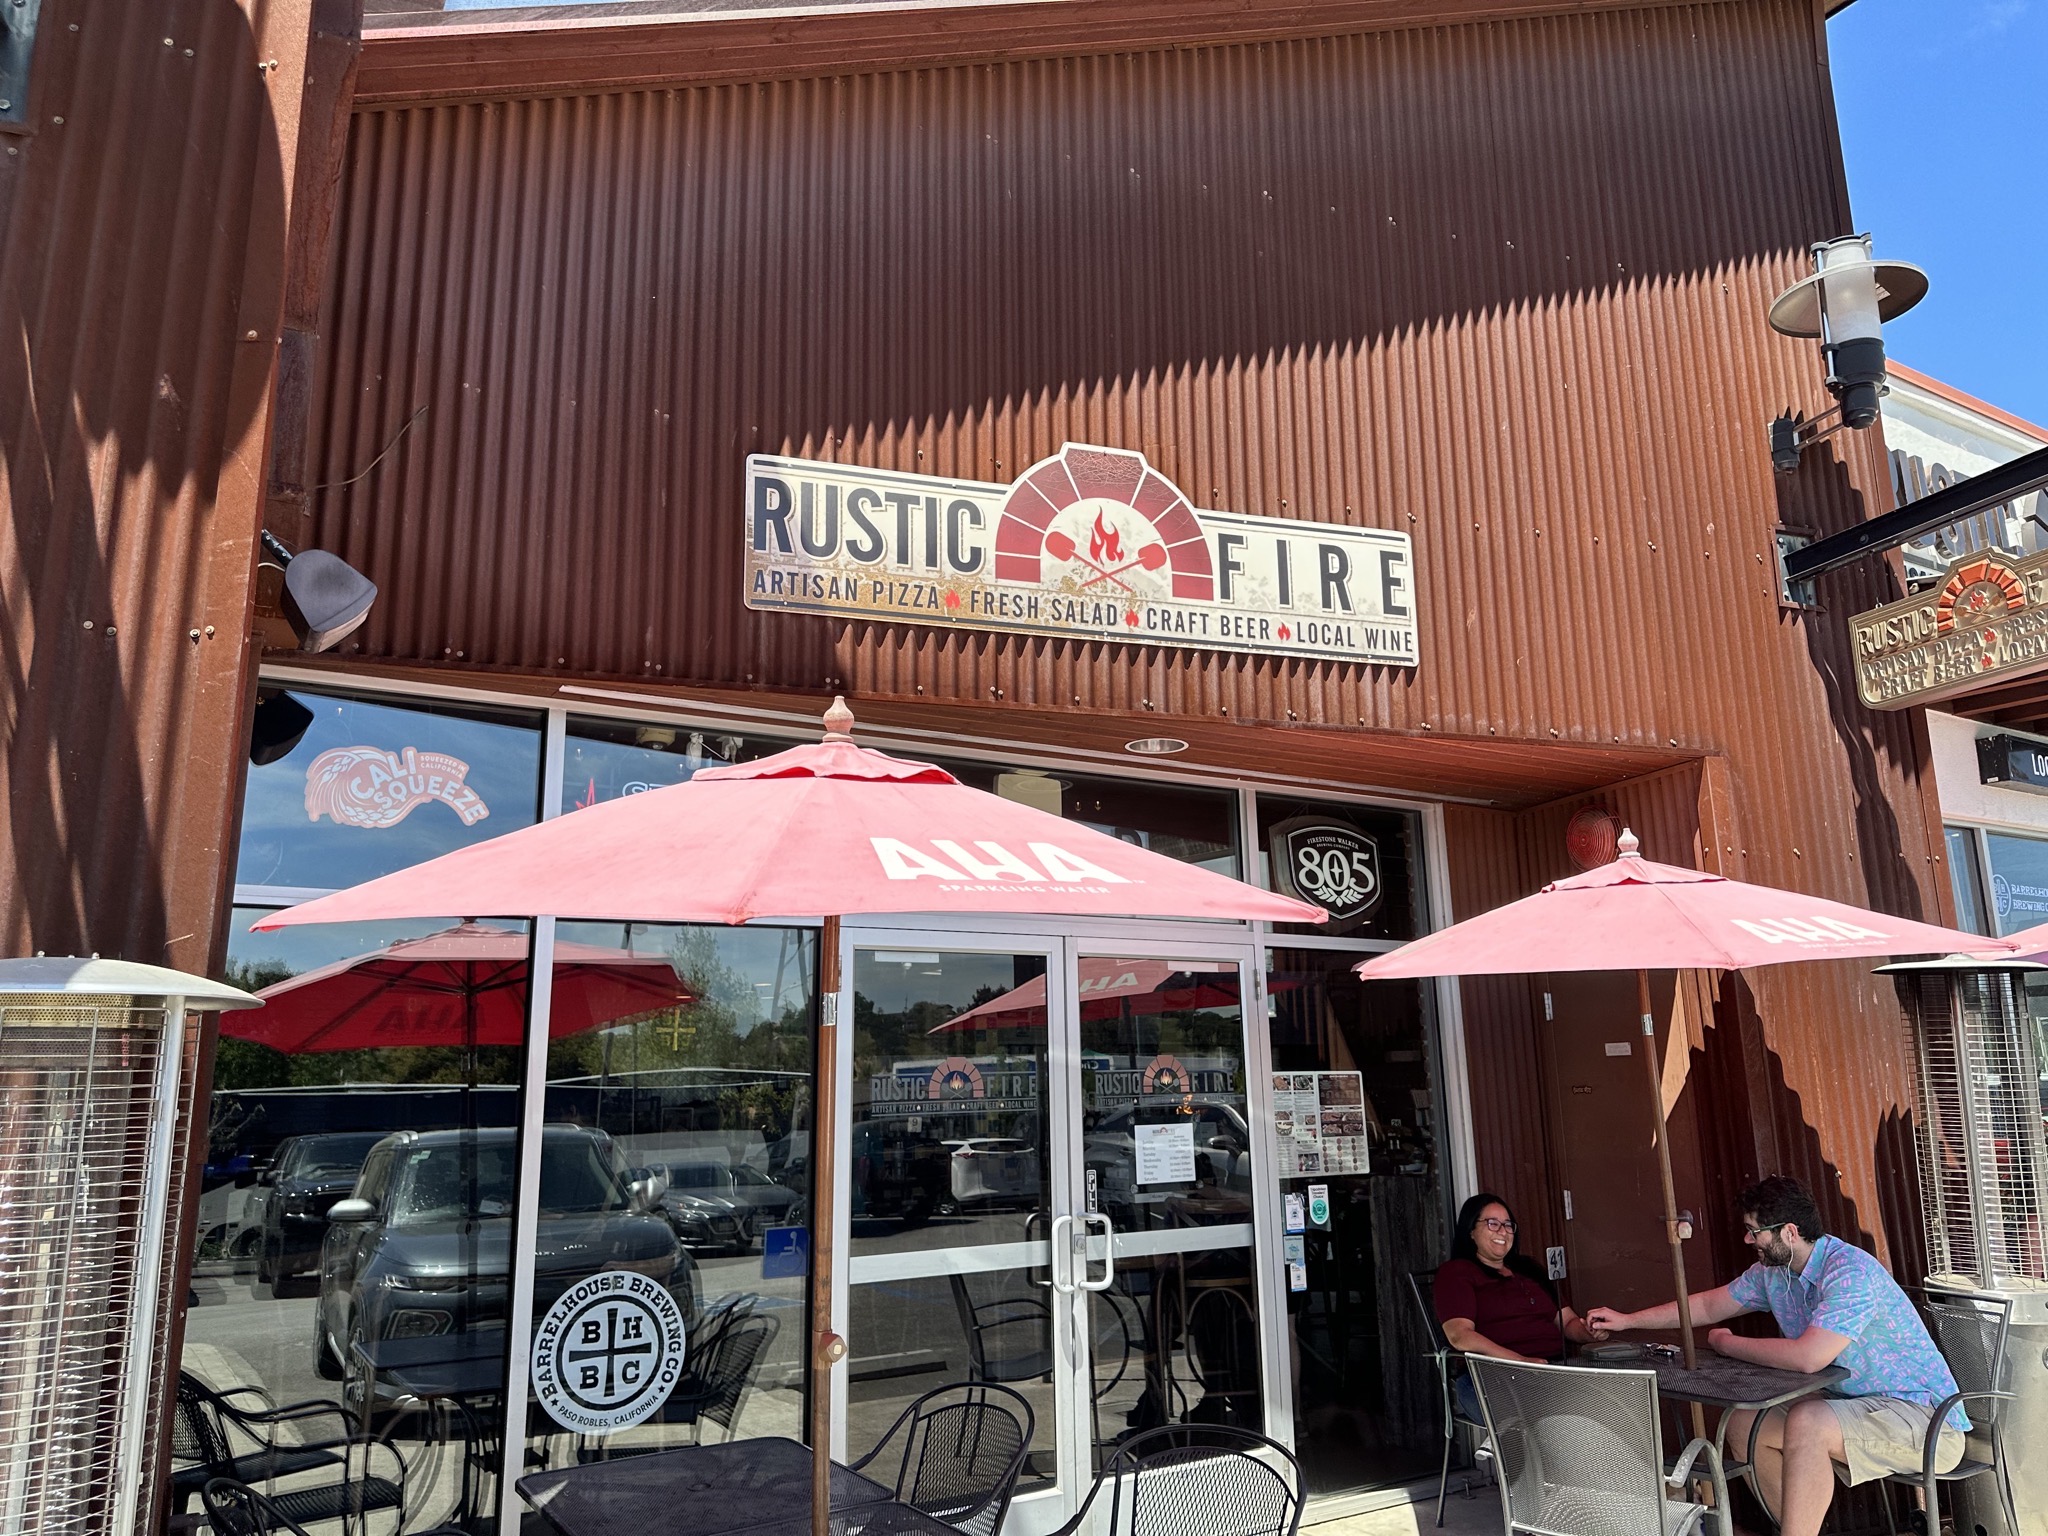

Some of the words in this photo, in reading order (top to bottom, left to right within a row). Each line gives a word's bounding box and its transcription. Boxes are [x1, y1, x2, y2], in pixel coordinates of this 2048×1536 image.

[753, 476, 987, 574] RUSTIC
[1218, 533, 1409, 617] FIRE
[753, 570, 858, 602] ARTISAN
[873, 581, 939, 610] PIZZA
[970, 591, 1039, 619] FRESH
[1051, 599, 1117, 627] SALAD
[1146, 607, 1209, 635] CRAFT
[1221, 615, 1270, 640] BEER
[1297, 621, 1356, 648] LOCAL
[1365, 628, 1413, 653] WINE
[1858, 606, 1937, 656] RUSTIC
[1863, 646, 1927, 681] ARTISAN
[1935, 630, 1983, 660] PIZZA
[2001, 609, 2048, 639] FRES
[1880, 668, 1929, 699] CRAFT
[1933, 656, 1976, 681] BEER
[1999, 634, 2048, 666] LOCA
[350, 751, 417, 799] CALI
[420, 755, 458, 767] SQUEEZED
[458, 764, 466, 772] IN
[420, 763, 463, 779] CALIFORNIA
[373, 775, 487, 822] SQUEEZE
[1307, 836, 1336, 845] FIRESTONE
[1337, 837, 1359, 850] WALKER
[869, 837, 1133, 884] AHA
[1298, 847, 1375, 894] 805
[939, 884, 1047, 894] SPARKLING
[1051, 885, 1111, 894] WATER
[1730, 916, 1893, 944] AHA
[871, 1077, 925, 1101] RUSTIC
[987, 1075, 1037, 1098] FIRE
[1095, 1072, 1140, 1095] RUSTIC
[1192, 1072, 1234, 1093] FIRE
[871, 1105, 897, 1114] ARTISAN
[899, 1104, 916, 1112] PIZZA
[922, 1104, 941, 1112] FRESH
[1004, 1101, 1021, 1109] LOCAL
[1023, 1100, 1037, 1108] WINE
[912, 1119, 918, 1127] 9
[537, 1276, 625, 1400] BARRELHOUSE
[629, 1277, 681, 1353] BREWING
[661, 1358, 679, 1383] CO
[581, 1320, 601, 1344] B
[622, 1316, 643, 1340] H
[580, 1365, 599, 1389] B
[622, 1360, 640, 1384] C
[558, 1405, 578, 1422] PASO
[578, 1416, 610, 1427] ROBLES,
[614, 1395, 659, 1425] CALIFORNIA
